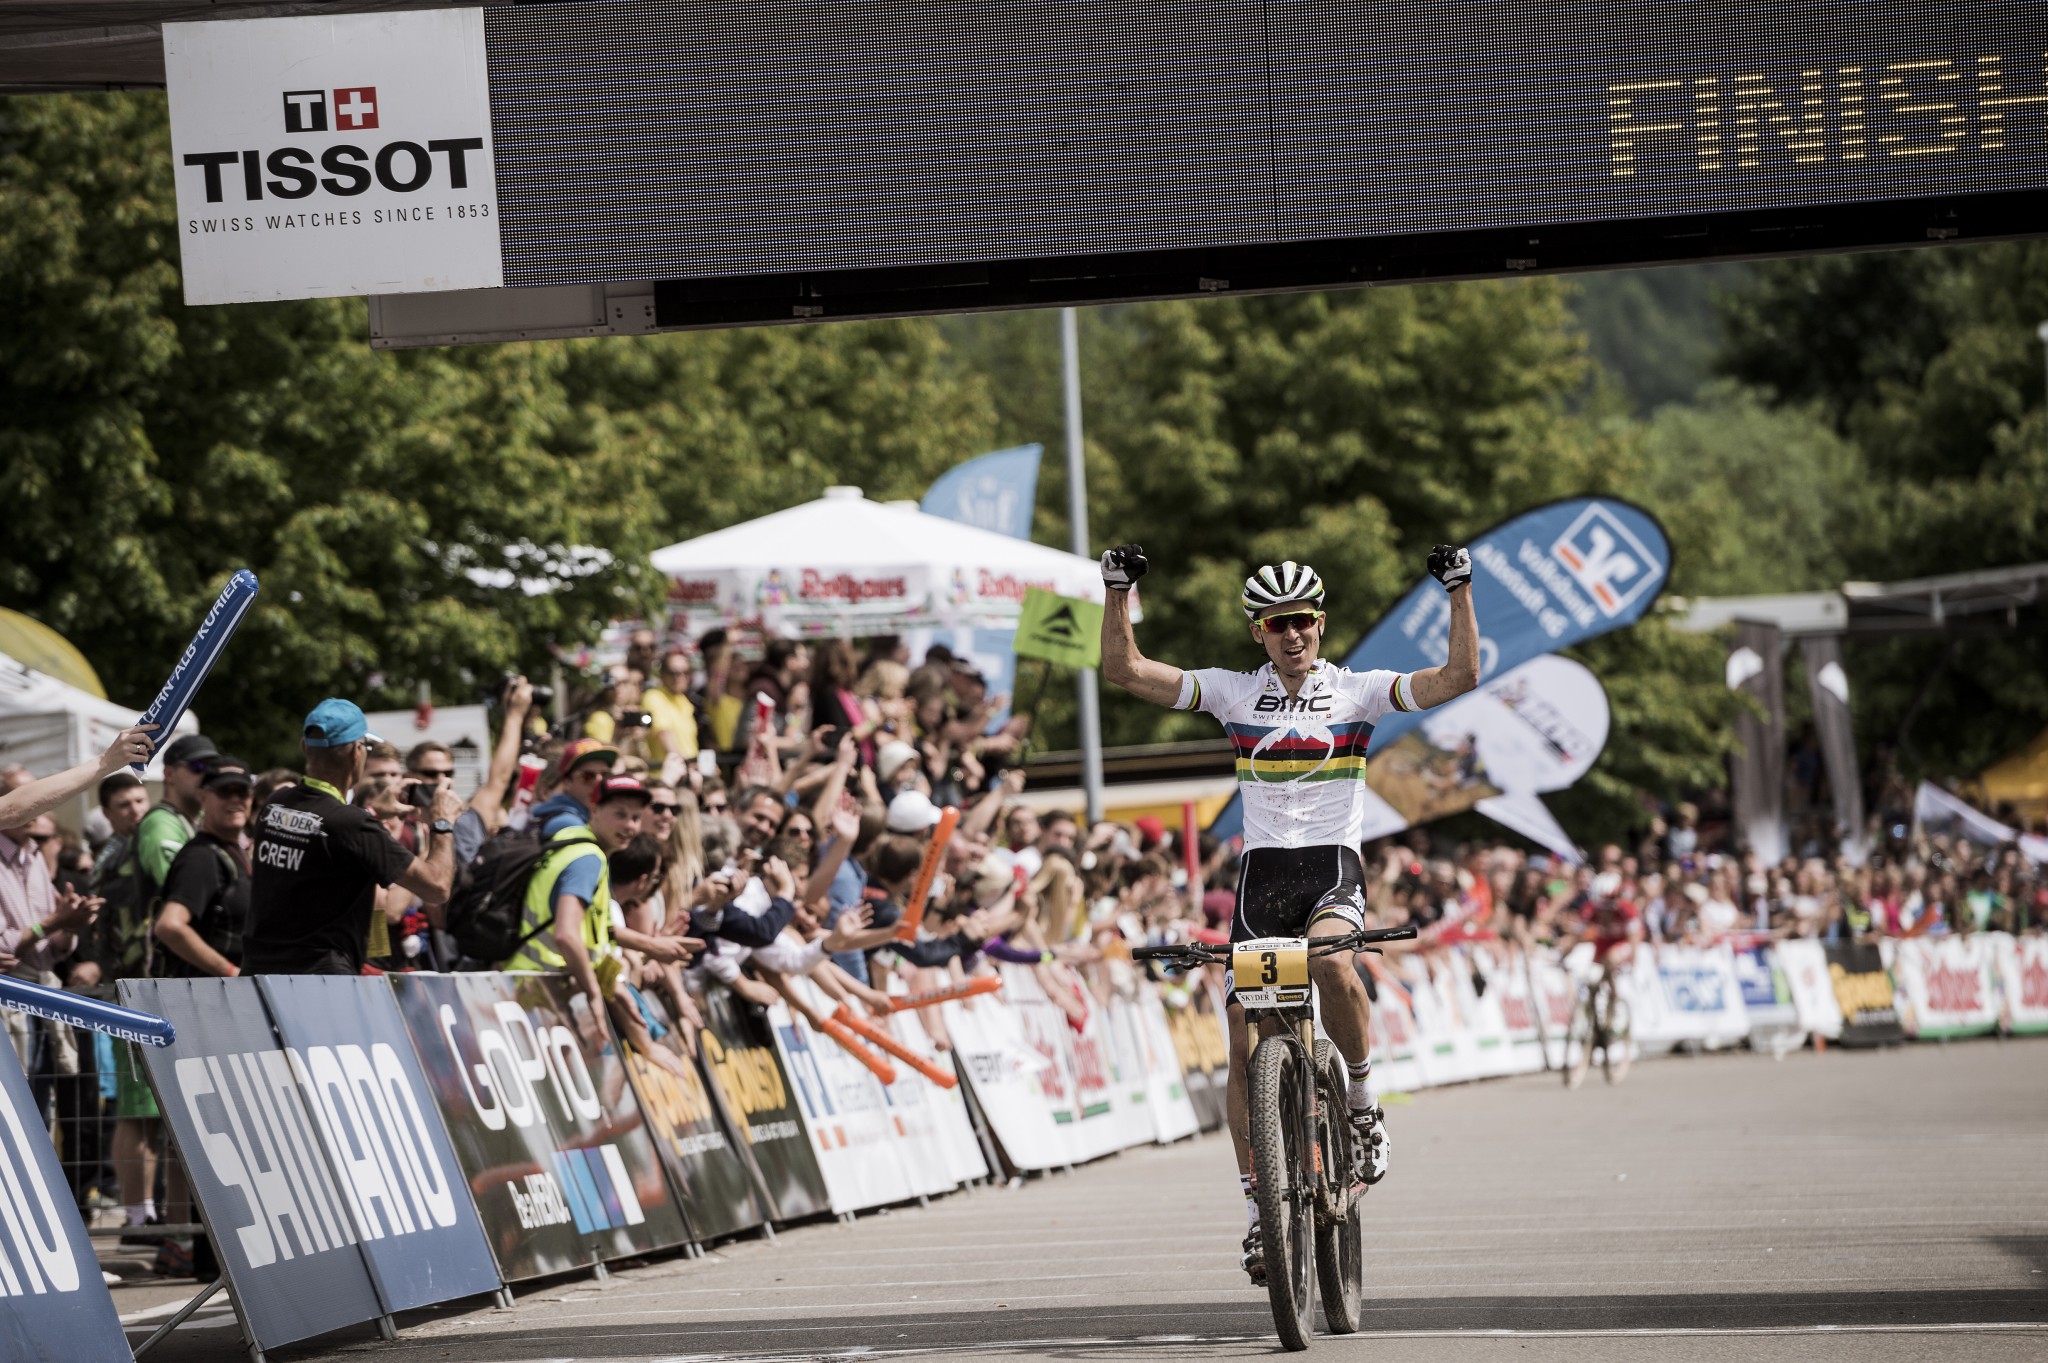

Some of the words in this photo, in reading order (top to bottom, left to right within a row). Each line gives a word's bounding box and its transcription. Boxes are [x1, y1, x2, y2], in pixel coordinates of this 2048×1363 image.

[1609, 54, 2048, 175] FINISH
[184, 138, 483, 203] TISSOT
[189, 217, 254, 234] SWISS
[266, 211, 362, 230] WATCHES
[374, 207, 435, 223] SINCE
[447, 204, 490, 219] 1853
[143, 573, 245, 724] LERN-ALB-KURIER
[1254, 695, 1332, 712] BMC
[271, 810, 313, 832] SKYDER
[259, 840, 305, 871] CREW
[1261, 952, 1278, 984] 3
[1241, 994, 1269, 1002] SKYDER
[440, 1001, 602, 1131] GoPro
[175, 1043, 457, 1268] SHIMANO
